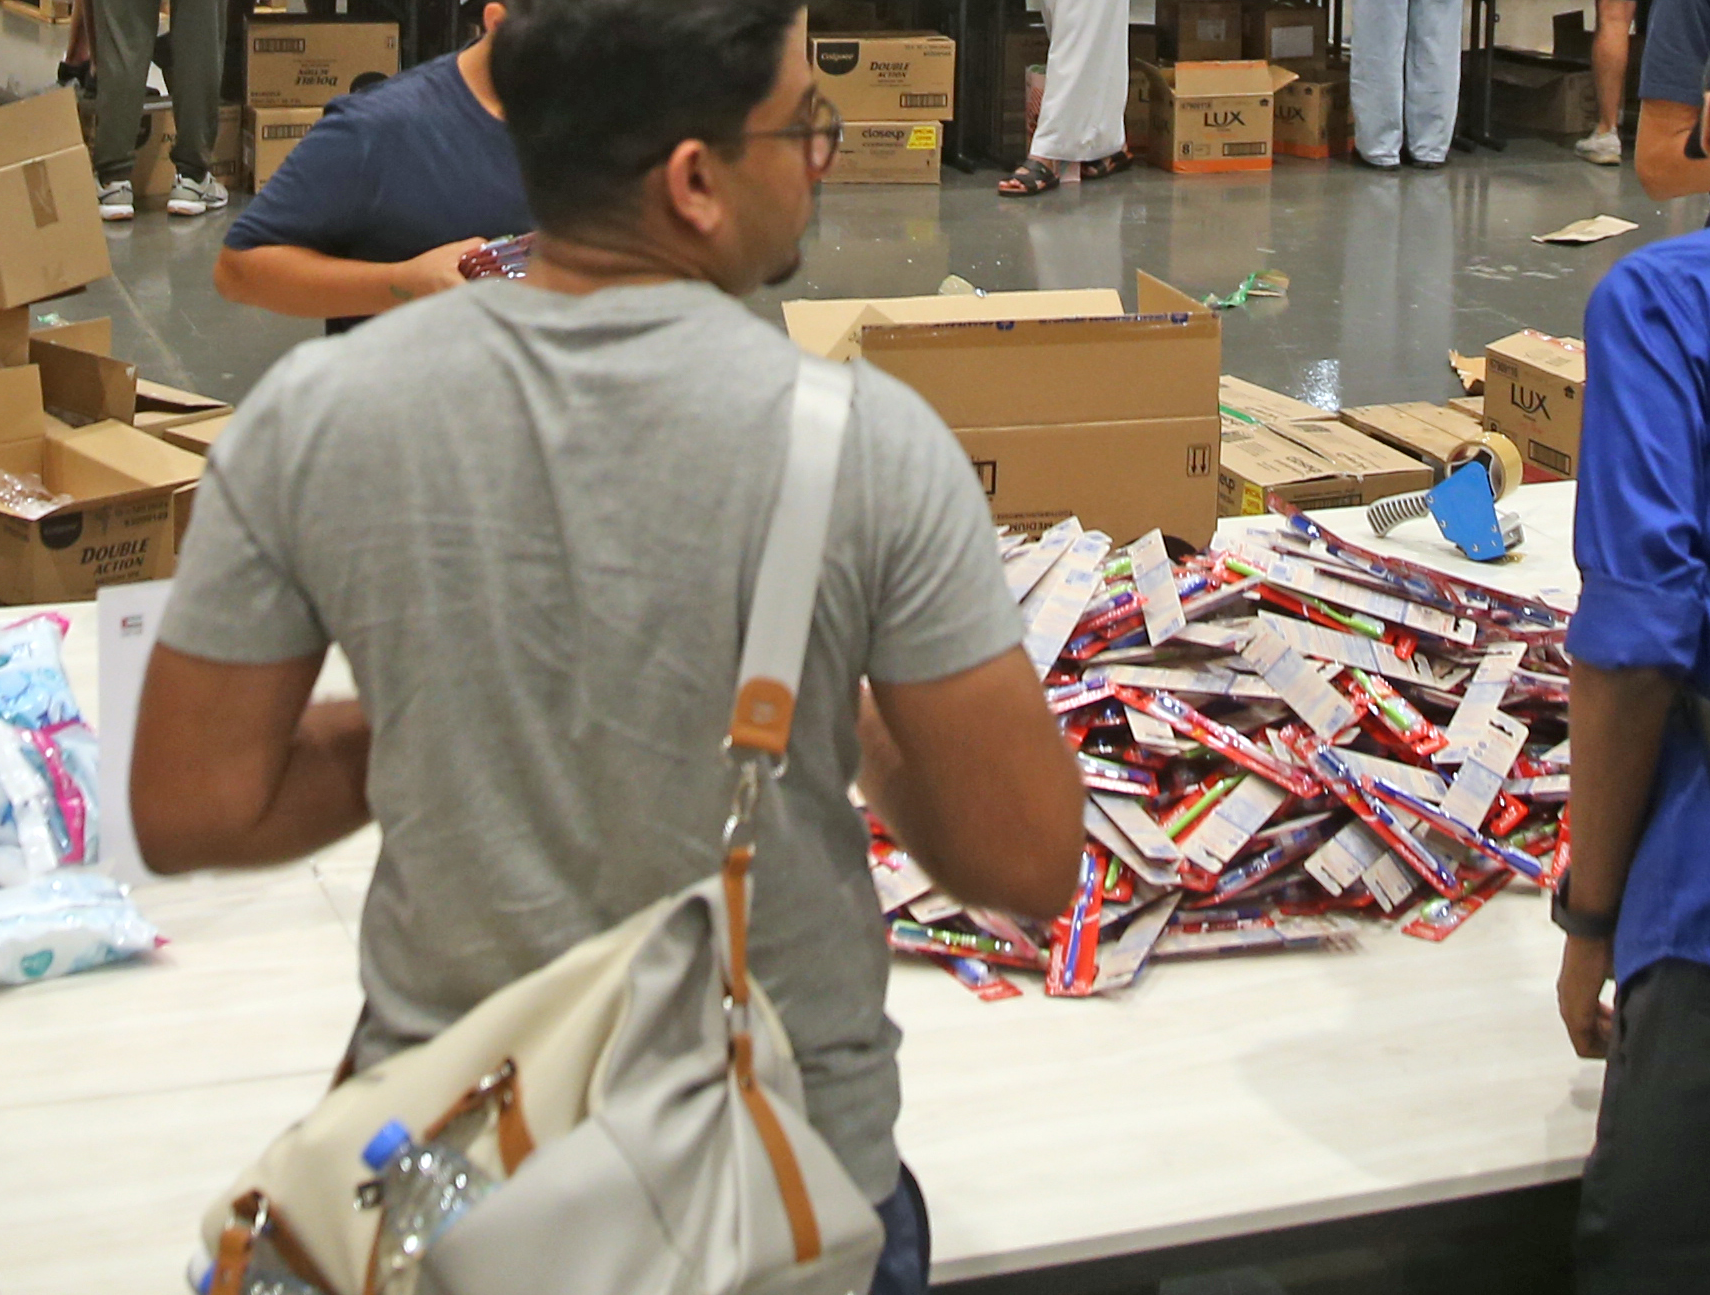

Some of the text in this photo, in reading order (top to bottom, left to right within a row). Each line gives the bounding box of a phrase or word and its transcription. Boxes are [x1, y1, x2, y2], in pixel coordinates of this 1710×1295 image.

[869, 61, 910, 72] DOUBLE
[1204, 111, 1246, 128] LUX
[861, 127, 905, 141] closeup
[1181, 143, 1190, 155] 8
[1511, 382, 1552, 421] LUX
[80, 538, 150, 566] DOUBLE
[94, 556, 147, 576] ACTION
